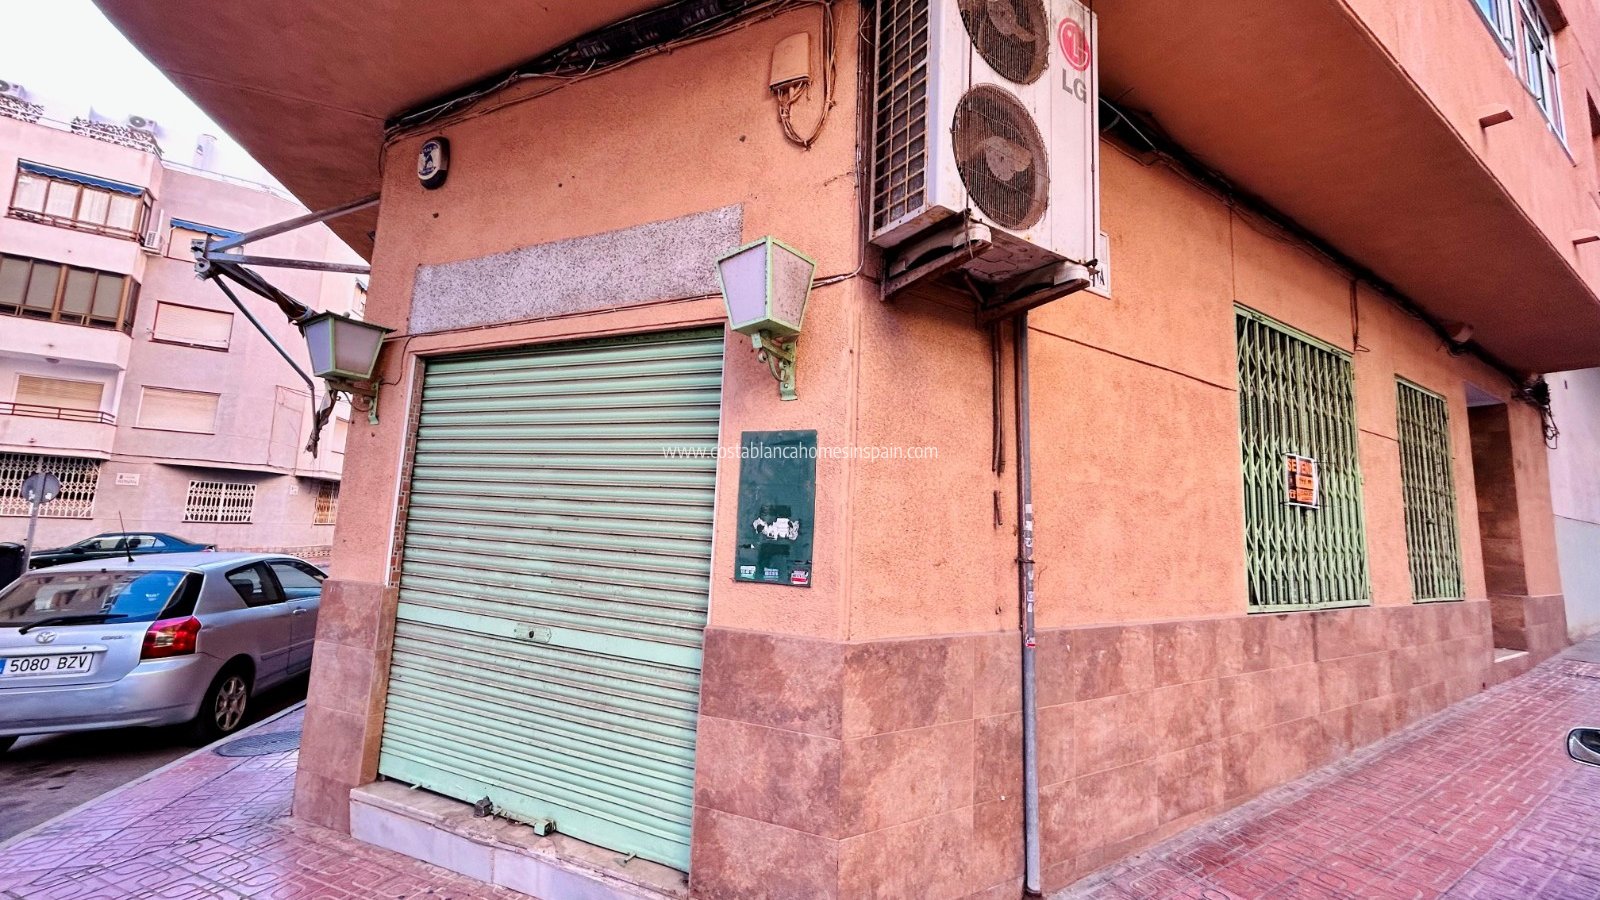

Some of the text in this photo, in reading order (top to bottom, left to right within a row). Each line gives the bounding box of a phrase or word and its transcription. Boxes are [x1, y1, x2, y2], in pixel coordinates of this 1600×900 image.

[1062, 68, 1087, 104] LG
[10, 655, 88, 673] 5080 BZV
